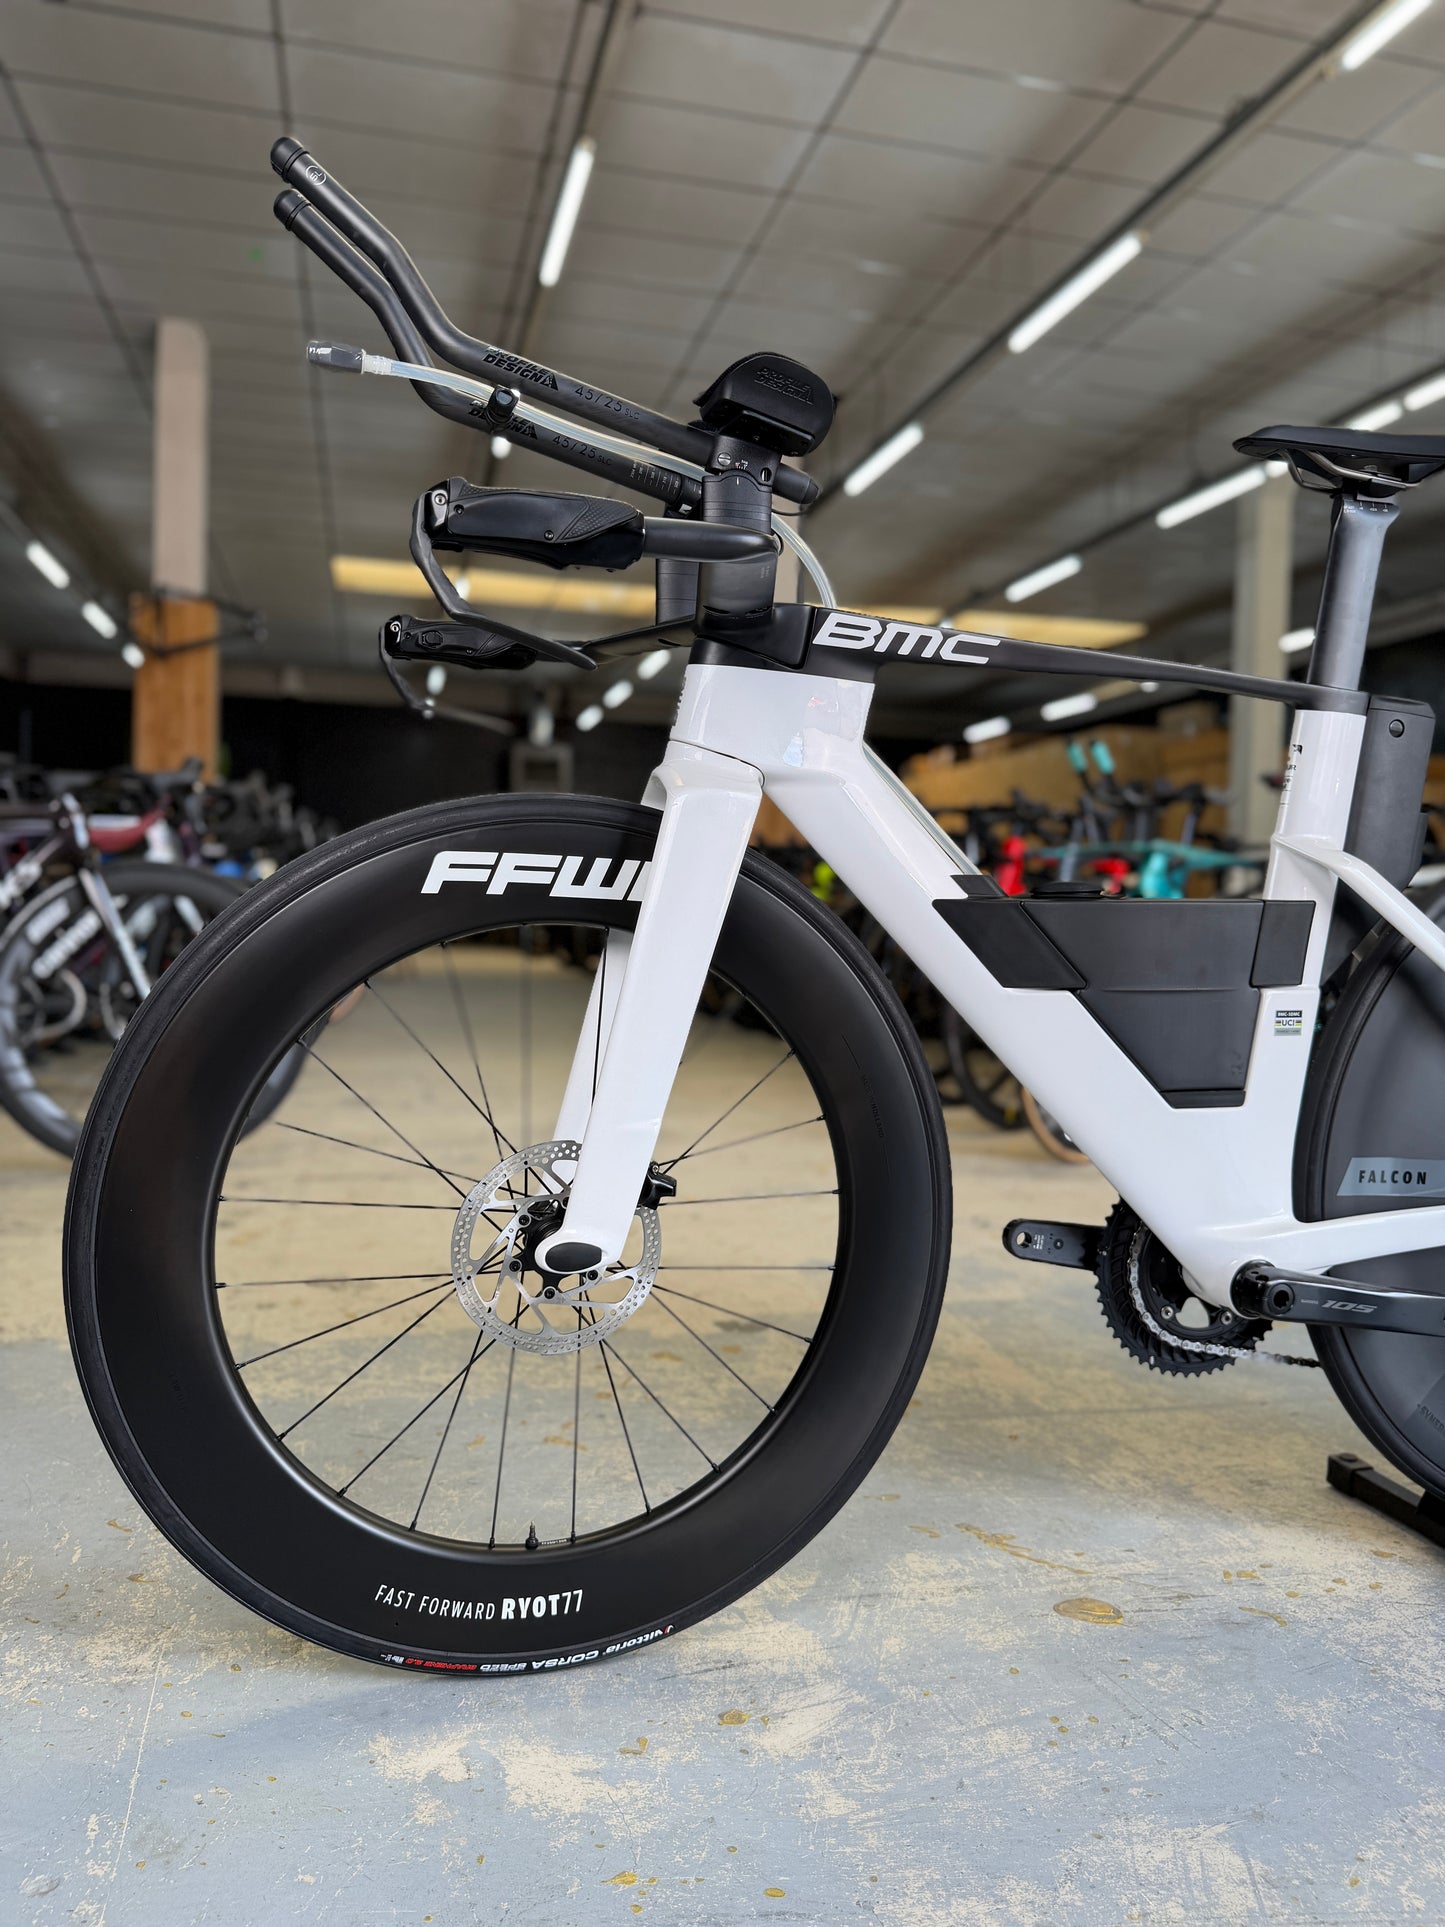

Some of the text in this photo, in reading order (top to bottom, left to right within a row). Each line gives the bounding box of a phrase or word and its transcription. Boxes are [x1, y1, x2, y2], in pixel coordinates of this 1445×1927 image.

[812, 612, 1002, 665] BMC
[1281, 1019, 1295, 1027] UCI
[1358, 1169, 1427, 1185] FALCON
[1321, 1299, 1378, 1313] 105
[374, 1583, 416, 1610] FAST
[418, 1595, 496, 1621] FORWARD
[479, 1662, 527, 1673] SPEED
[531, 1649, 600, 1670] CORSA
